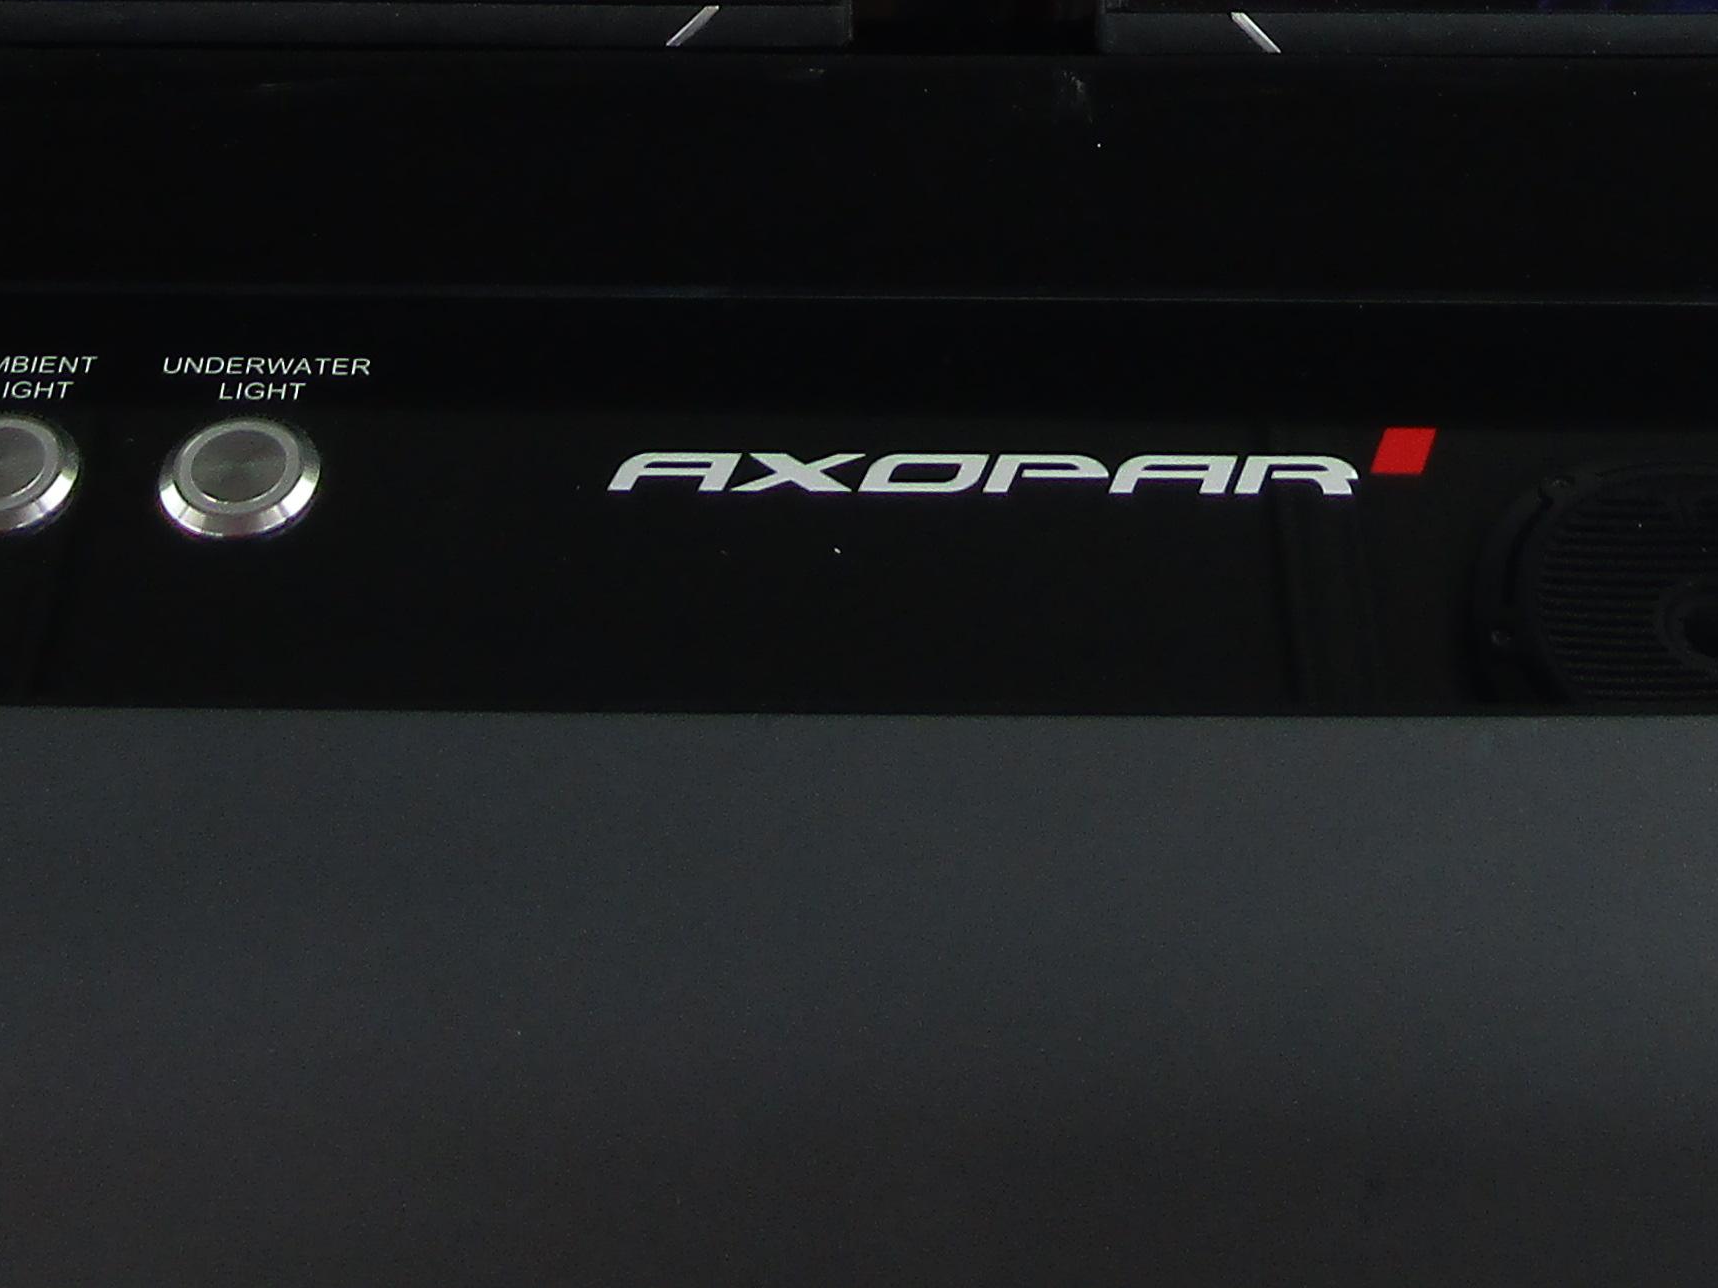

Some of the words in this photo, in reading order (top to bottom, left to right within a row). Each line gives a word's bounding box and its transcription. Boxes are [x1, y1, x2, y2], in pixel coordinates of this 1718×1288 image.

[163, 356, 371, 376] UNDERWATER
[219, 381, 306, 400] LIGHT
[607, 452, 1359, 496] AXOPAR
